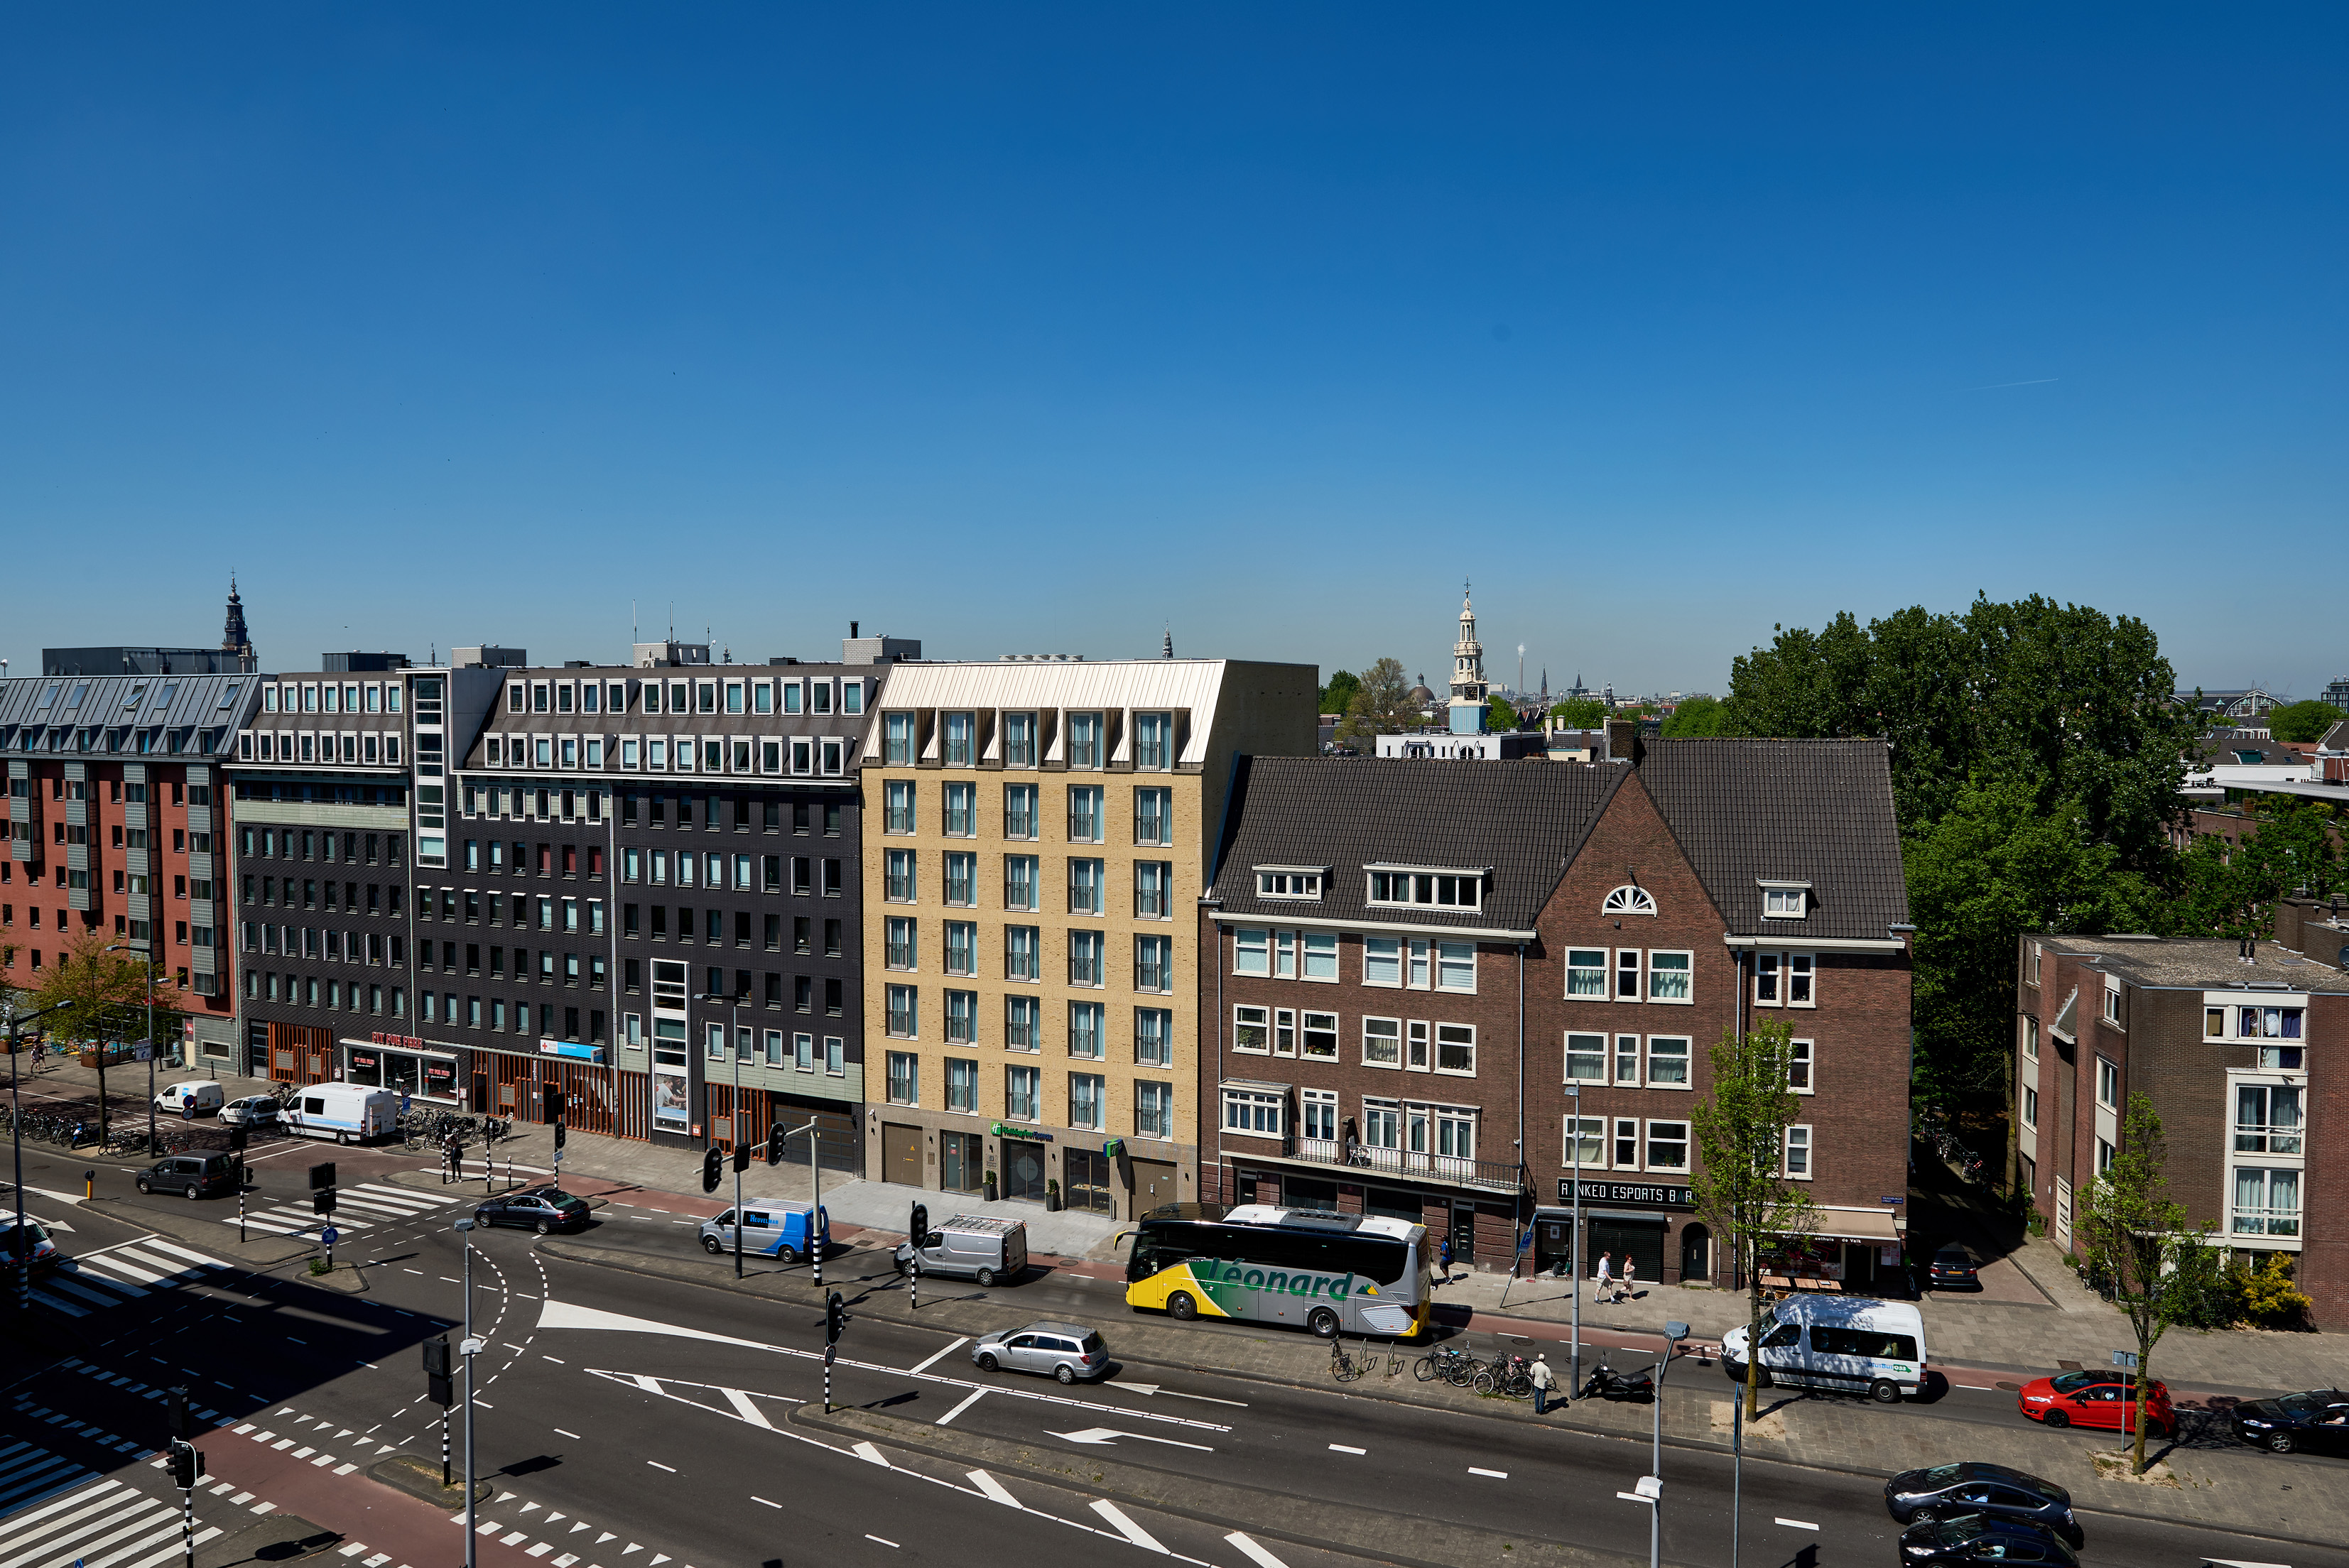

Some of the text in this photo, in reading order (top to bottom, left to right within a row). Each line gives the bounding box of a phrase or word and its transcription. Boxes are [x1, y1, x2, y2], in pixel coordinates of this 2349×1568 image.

[372, 1032, 423, 1049] FIT FOR FREE
[1002, 1126, 1022, 1136] Holiday
[1033, 1131, 1053, 1140] Express
[1561, 1183, 1692, 1203] RANKED ESPORTS BAR
[1208, 1257, 1355, 1301] léonard
